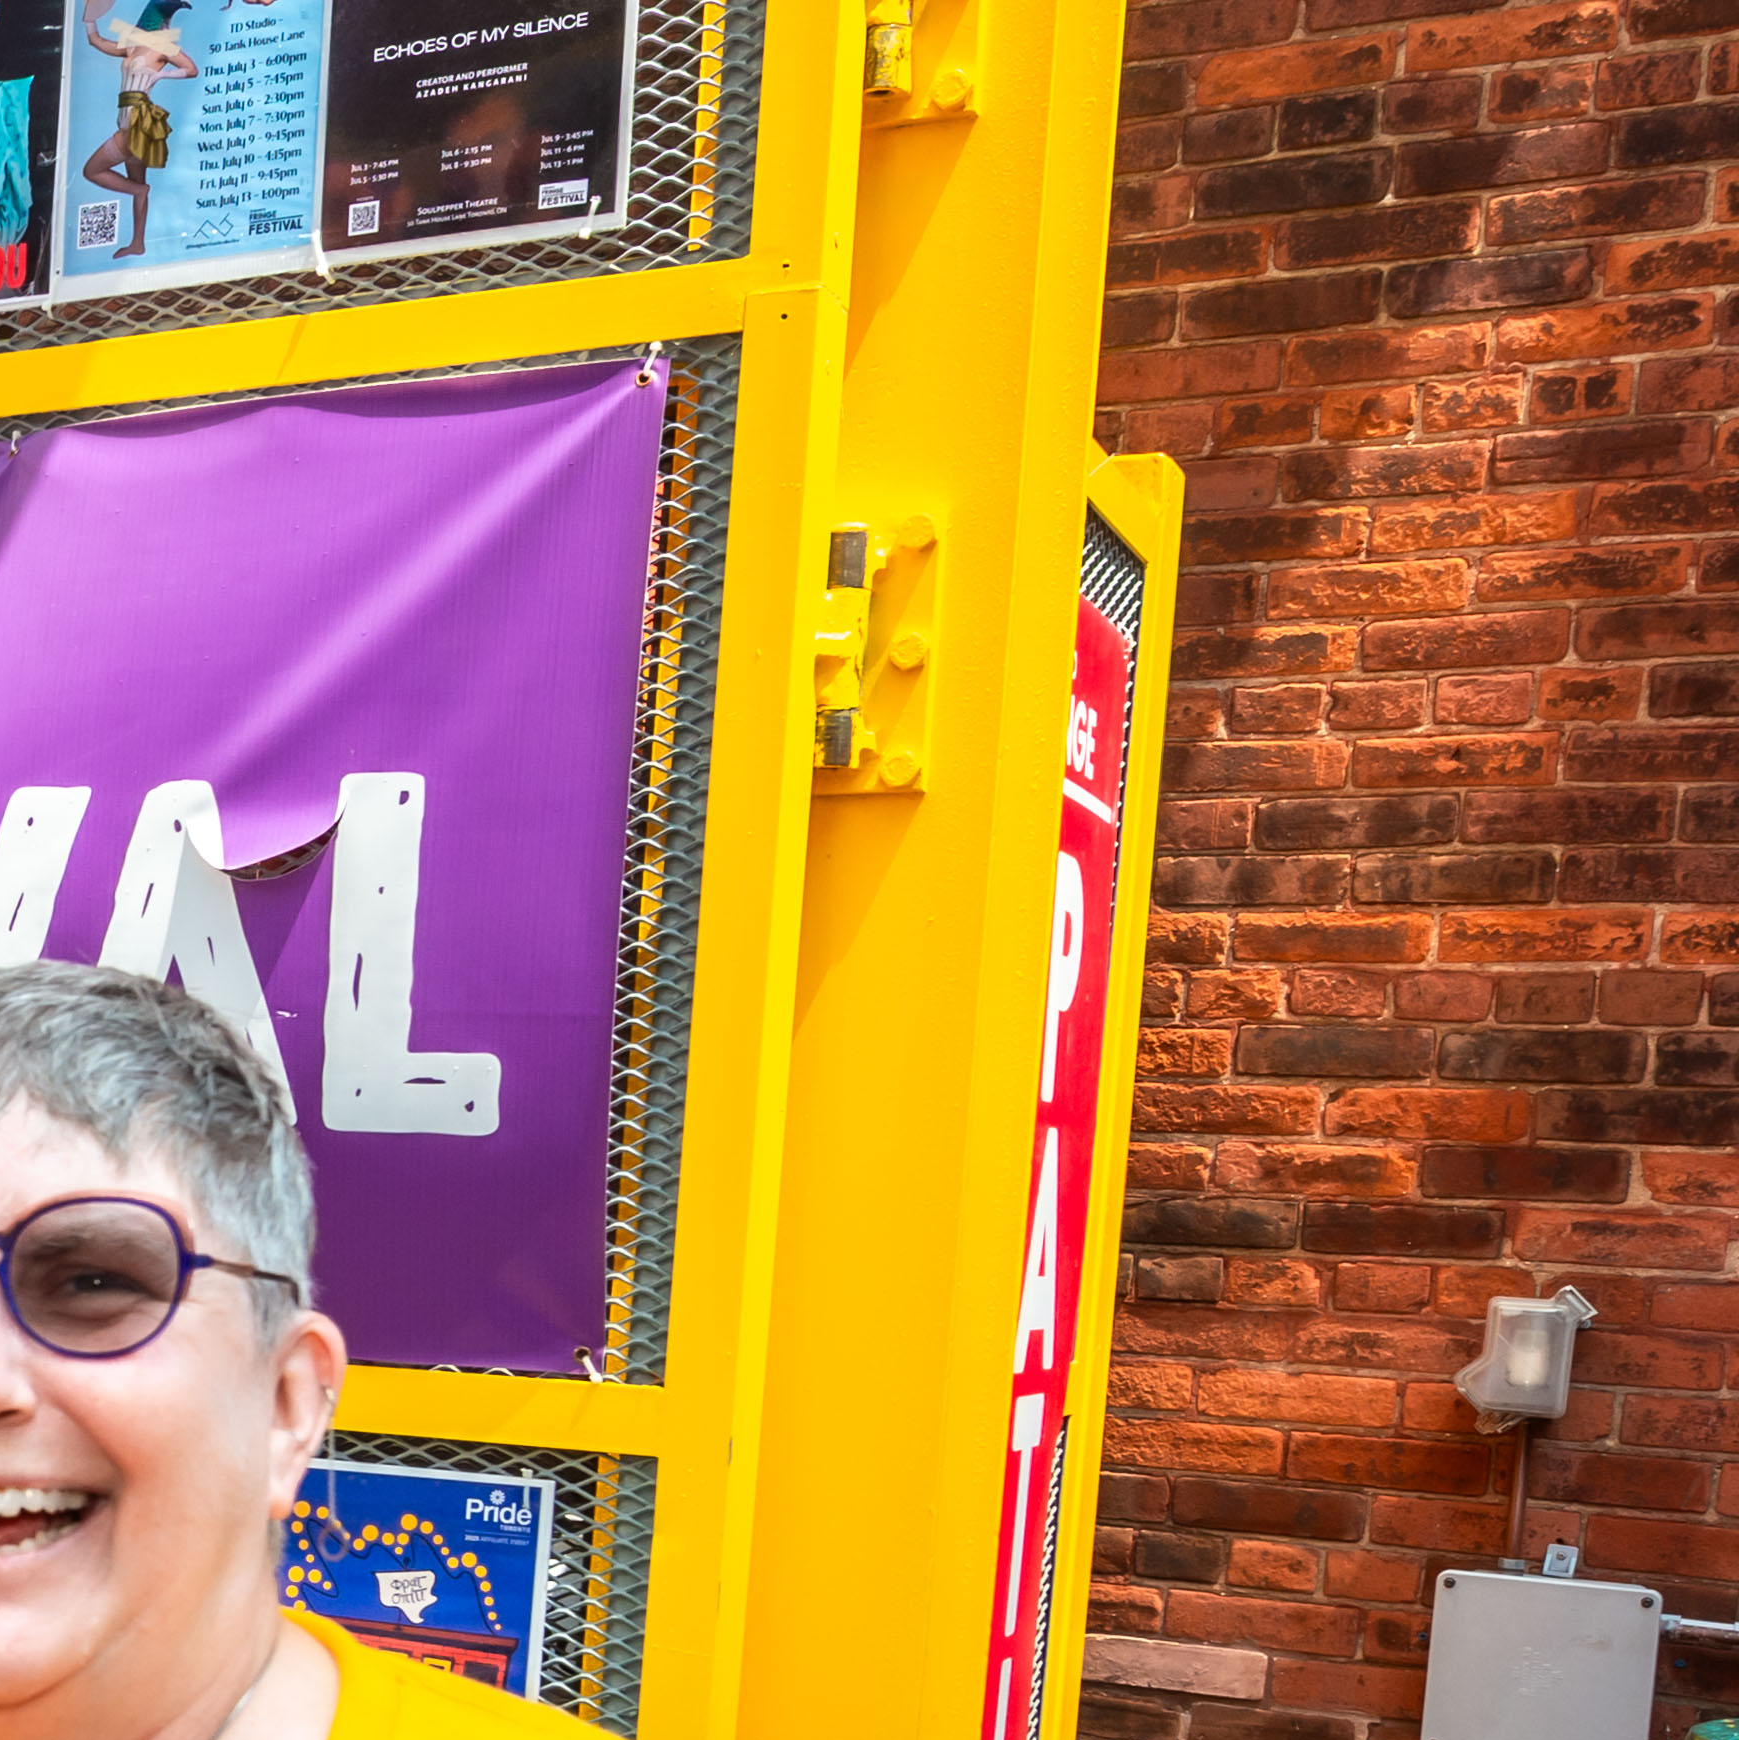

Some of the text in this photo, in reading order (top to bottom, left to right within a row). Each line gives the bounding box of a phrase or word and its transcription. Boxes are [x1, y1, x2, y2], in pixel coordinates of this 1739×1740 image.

[230, 18, 276, 34] TD Studio
[373, 12, 589, 63] ECHOES OF MY SILENCE
[209, 31, 306, 54] 50 Tank House Lane
[227, 61, 247, 76] July
[250, 59, 256, 70] 3
[265, 52, 307, 67] 6:00pm
[416, 62, 529, 89] CREATOR AND PERFORMER
[225, 80, 245, 95] July
[247, 77, 254, 89] 5
[264, 71, 304, 86] 7:45pm
[225, 98, 245, 113] July
[247, 97, 254, 108] 6
[264, 91, 305, 105] 2:30pm
[226, 117, 246, 132] July
[248, 114, 255, 127] 7
[265, 109, 305, 124] 7:30pm
[226, 136, 246, 151] July
[248, 134, 255, 144] 9
[265, 128, 305, 142] 9:45pm
[223, 156, 242, 171] July
[244, 153, 255, 165] 10
[265, 148, 302, 162] 4:15pm
[219, 175, 238, 190] July
[241, 173, 248, 184] 11
[258, 167, 298, 182] 9:45pm
[219, 194, 240, 208] July
[261, 186, 300, 201] 1:00pm
[541, 192, 586, 208] FESTIVAL
[248, 217, 303, 236] FESTIVAL
[249, 209, 277, 221] FRINGE
[465, 1497, 533, 1526] Pride
